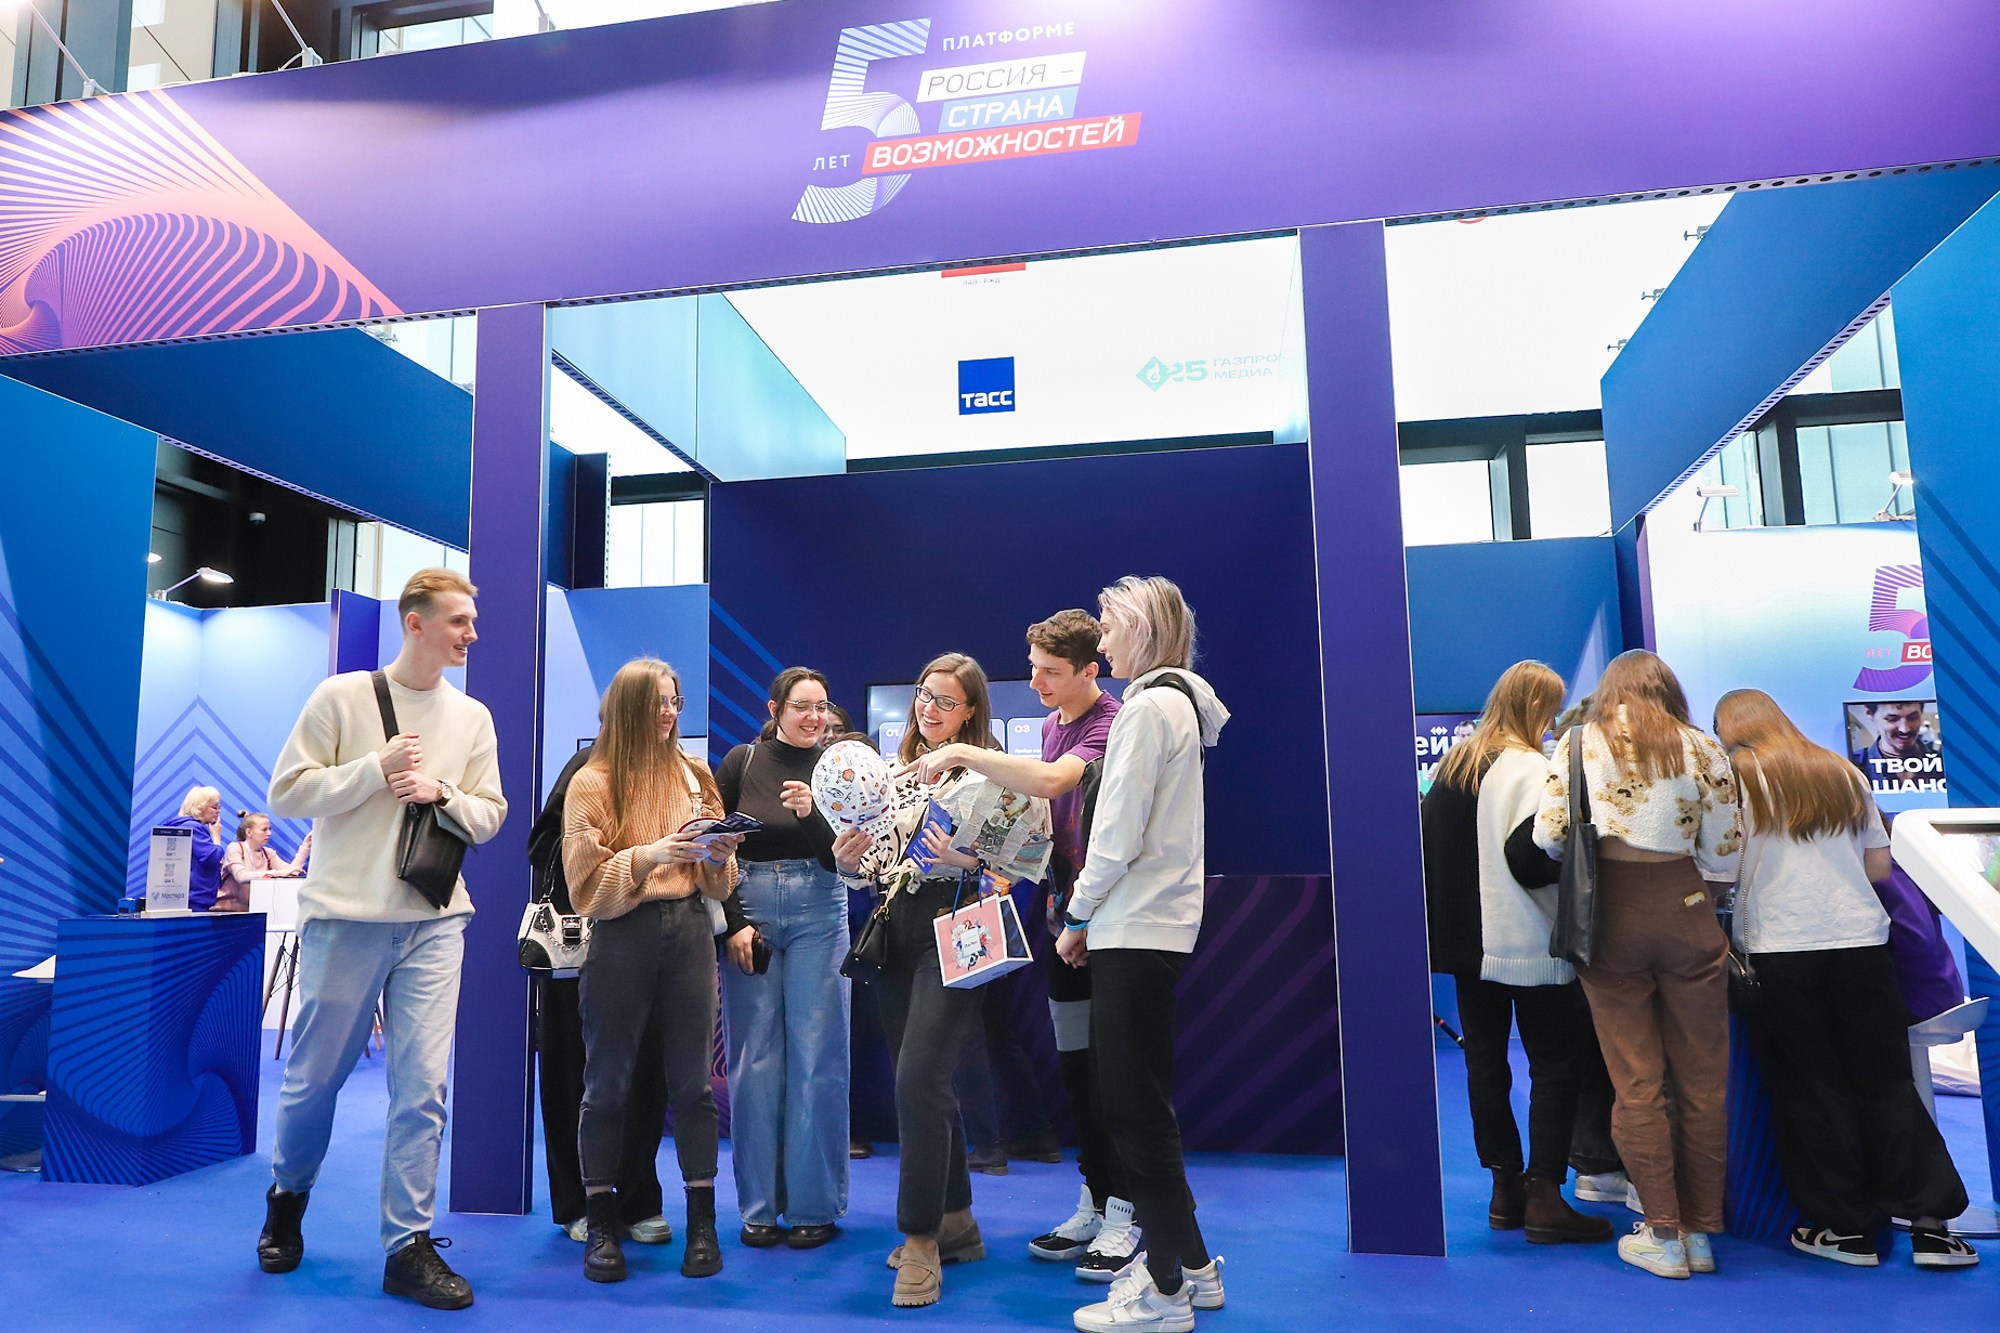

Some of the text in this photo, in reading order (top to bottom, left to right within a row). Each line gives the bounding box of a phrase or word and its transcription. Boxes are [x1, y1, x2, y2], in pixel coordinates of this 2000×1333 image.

[942, 21, 1076, 51] ПЛАТФОРМЕ
[927, 63, 1048, 96] РОССИЯ
[947, 94, 1065, 129] СТРАНА
[871, 116, 1126, 169] ВОЗМОЖНОСТЕЙ
[812, 154, 851, 171] ЛЕТ
[1213, 353, 1282, 367] ГАЗПРО
[1213, 367, 1274, 380] МЕДИА
[1014, 724, 1031, 733] 03
[1869, 753, 1943, 773] ТВОЙ
